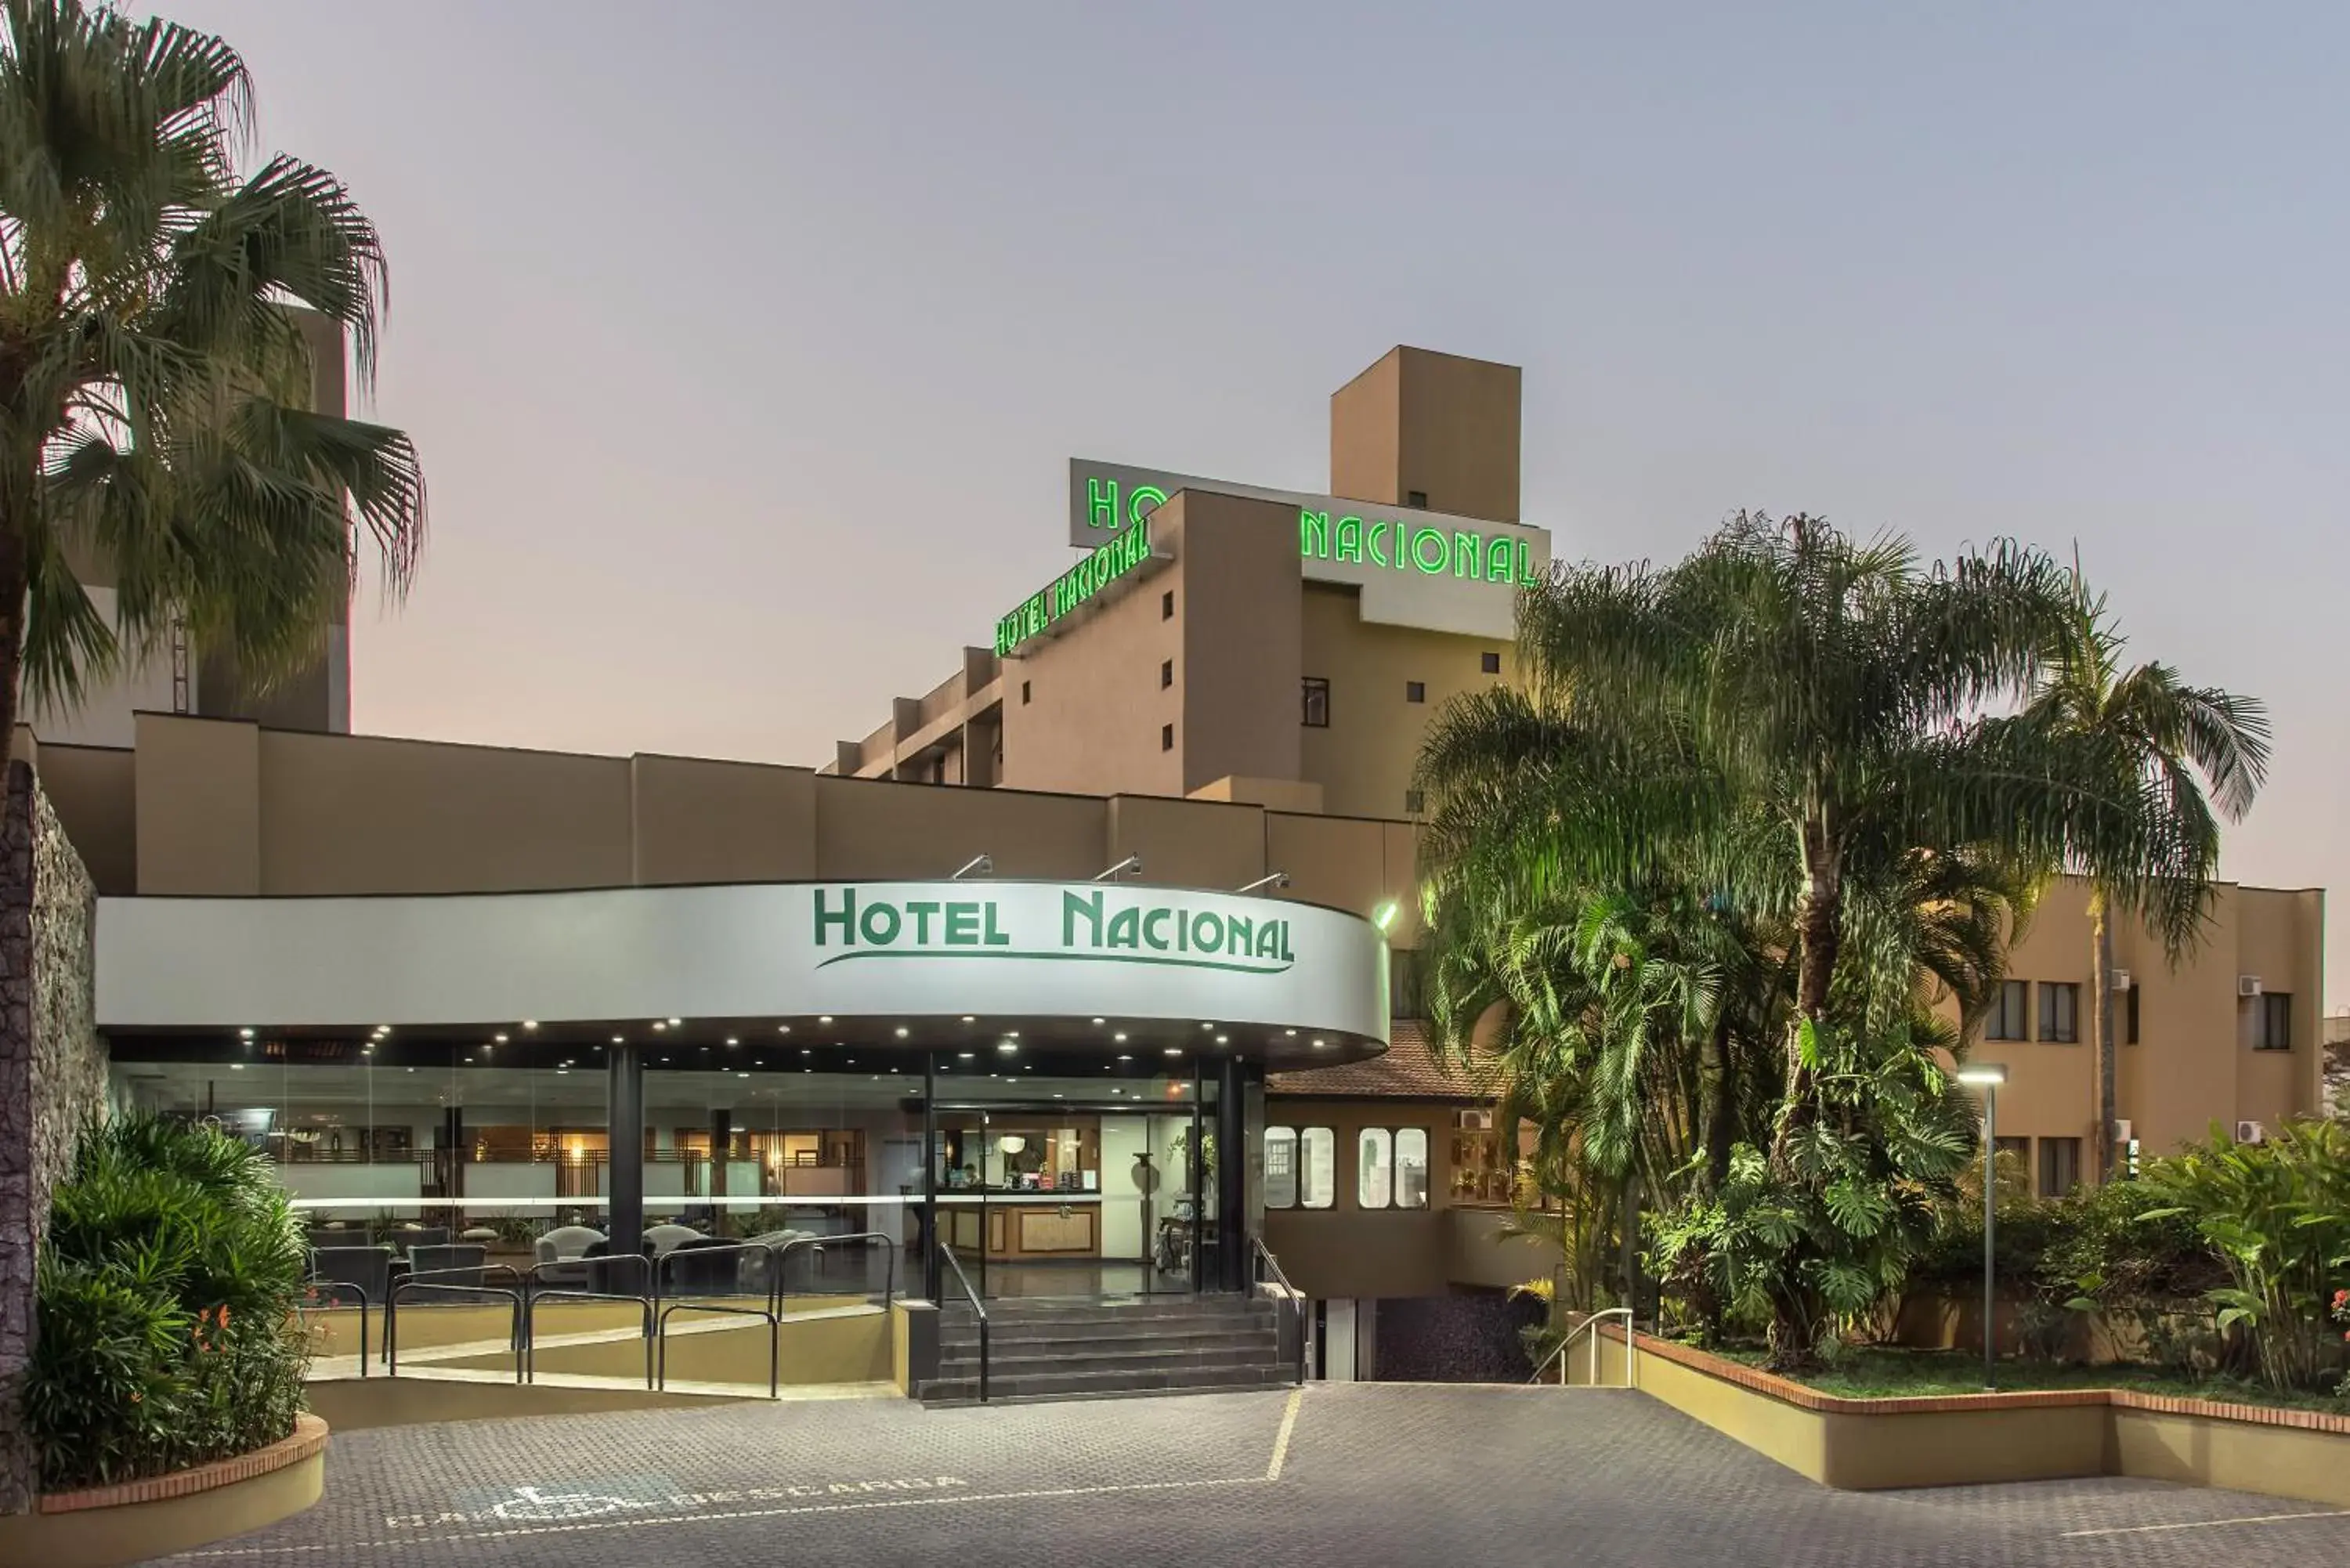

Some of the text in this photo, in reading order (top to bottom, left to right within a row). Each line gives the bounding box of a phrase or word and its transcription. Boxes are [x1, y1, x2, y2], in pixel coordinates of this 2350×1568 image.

[1301, 511, 1536, 587] NACIONAL
[996, 518, 1150, 658] HOTEL NACIONAL
[814, 887, 1295, 962] HOTEL NACIONAL
